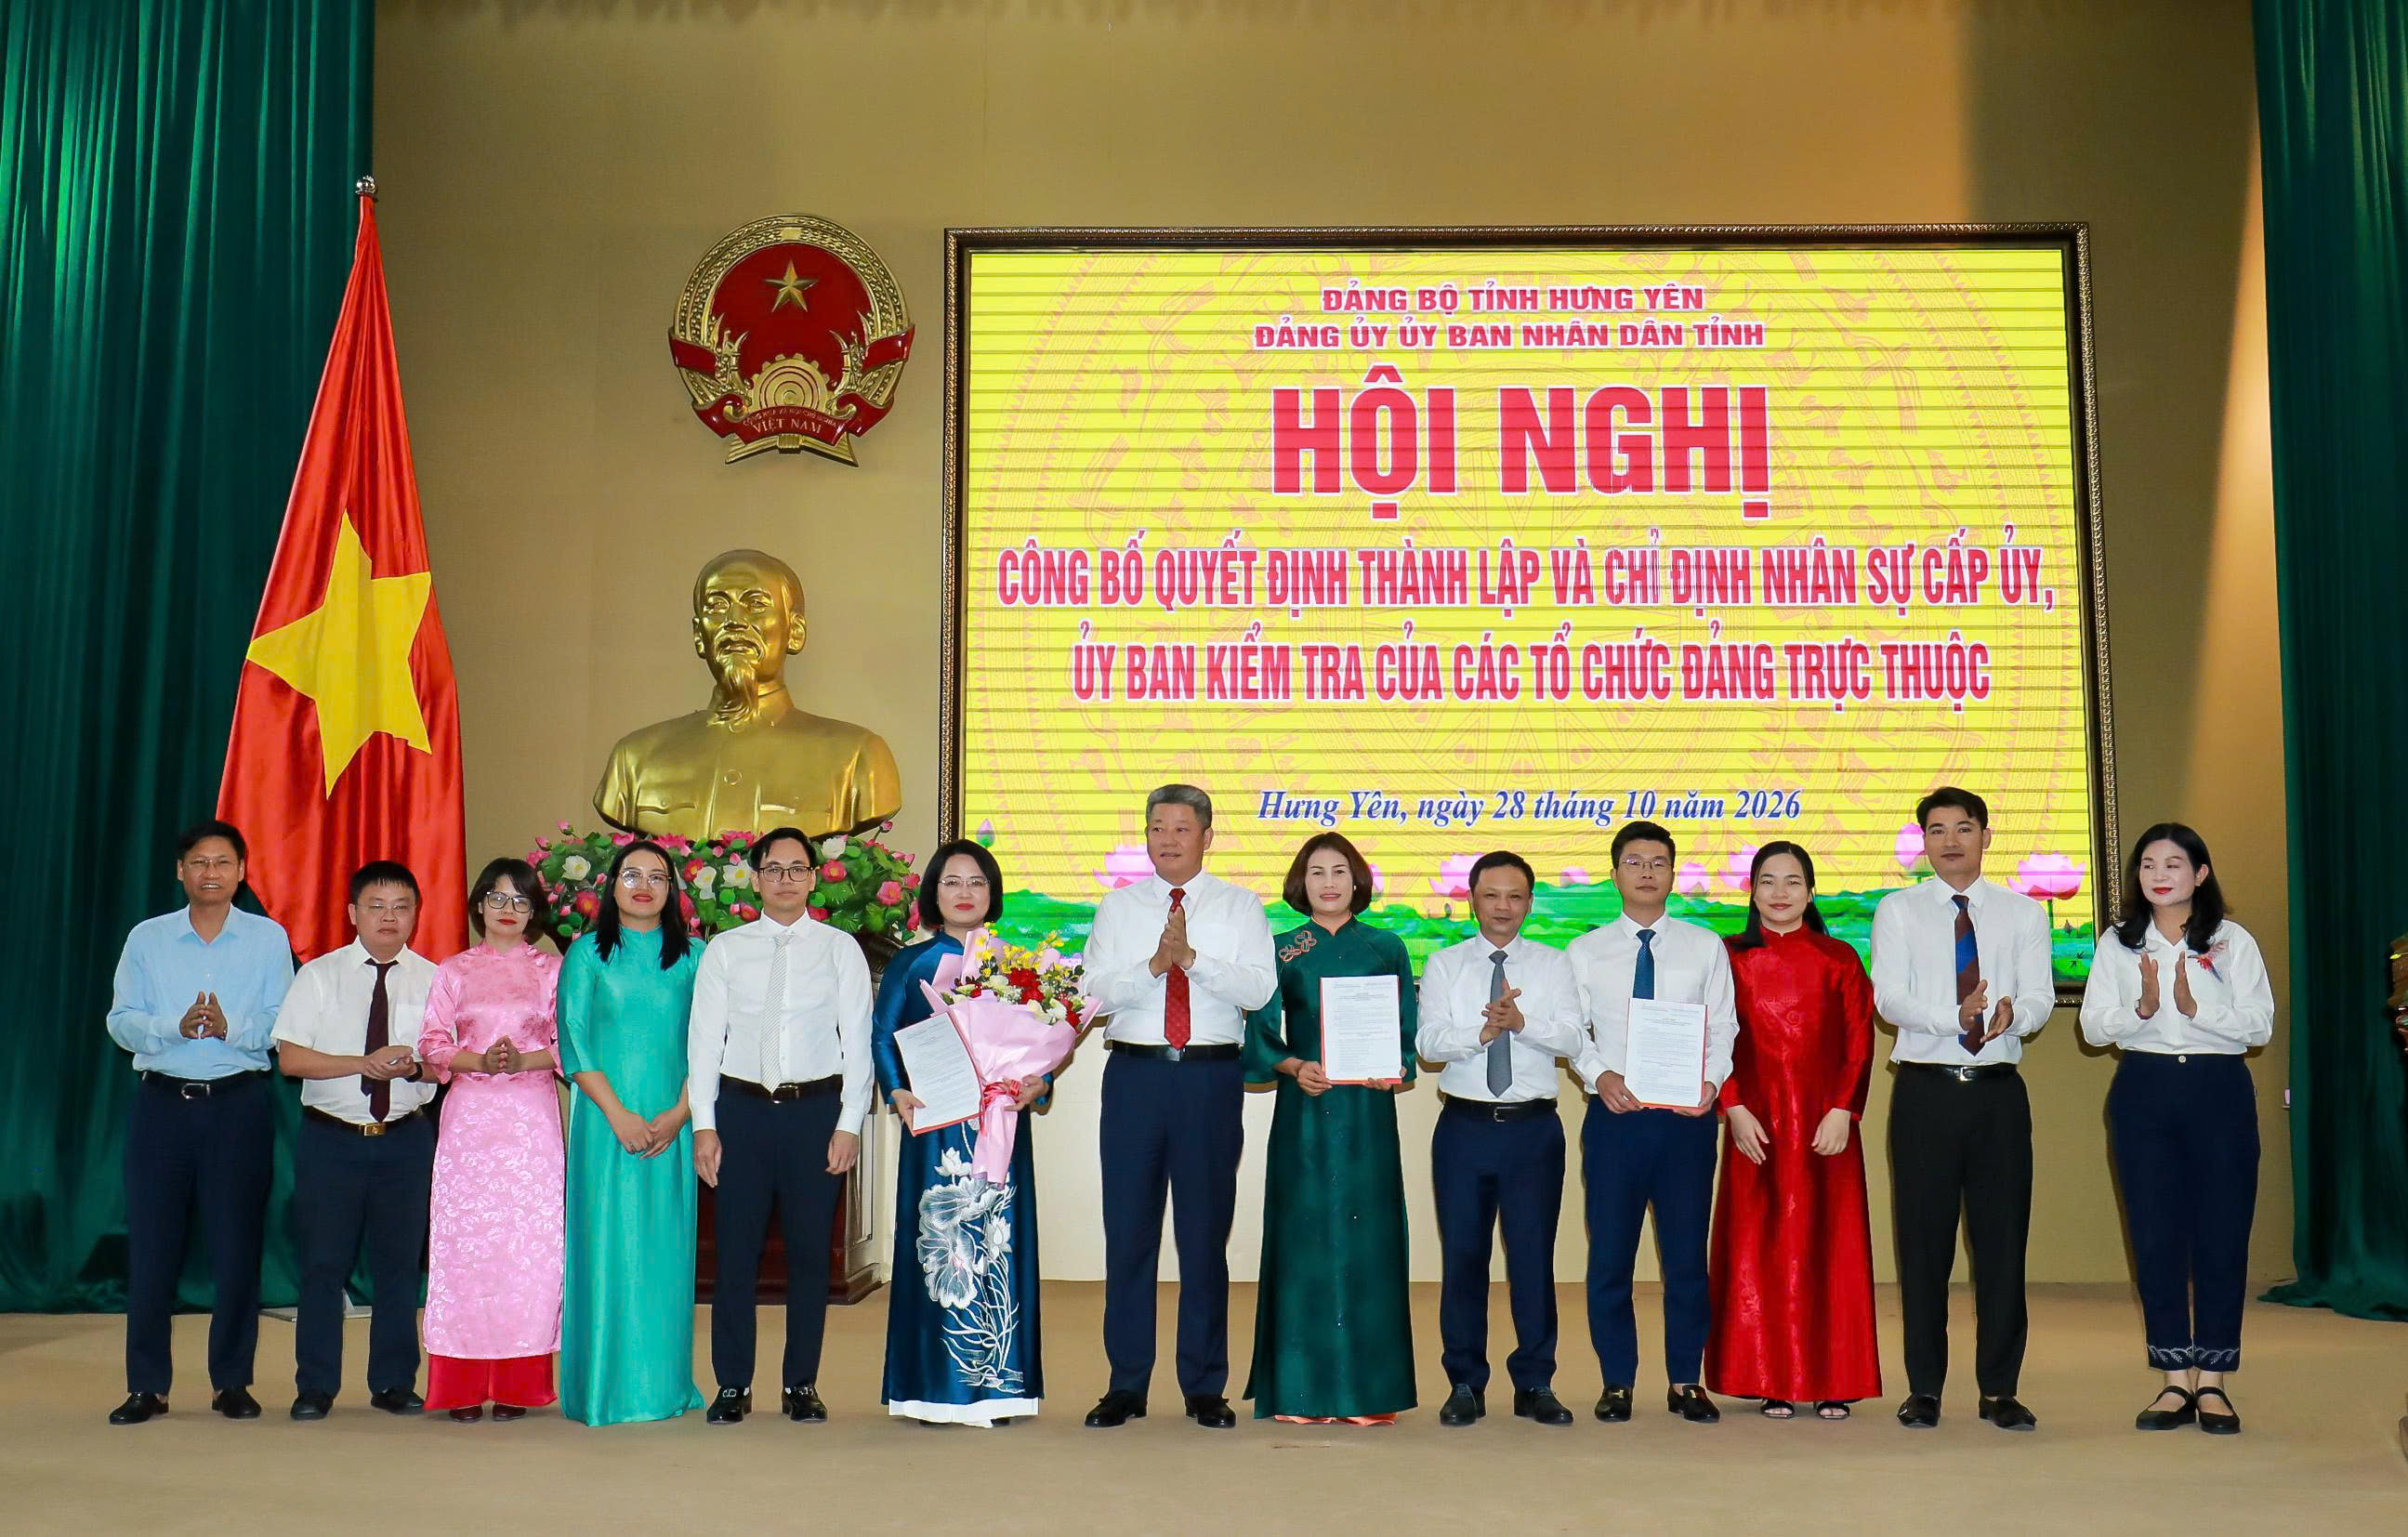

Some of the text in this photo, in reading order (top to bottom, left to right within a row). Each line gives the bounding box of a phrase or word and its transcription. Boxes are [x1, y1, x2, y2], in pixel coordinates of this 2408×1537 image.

[1323, 281, 1703, 314] ĐẢNG BỘ TỈNH HƯNG YÊN
[1256, 317, 1762, 347] ĐẢNG ỦY ỦY BAN NHÂN DÂN TỈNH
[791, 418, 822, 434] NAM
[1273, 366, 1769, 519] HỘI NGHỊ
[999, 525, 2052, 617] CÔNG BỐ QUYẾT ĐỊNH THÀNH LẬP VÀ CHỈ ĐỊNH NHÂN SỰ CẤP ỦY,
[1074, 621, 1989, 711] ỦY BAN KIỂM TRA CỦA CÁC TỔ CHỨC ĐẢNG TRỰC THUỘC
[1258, 791, 1799, 826] Hưng Yên, ngày 28 tháng 10 năm 2026
